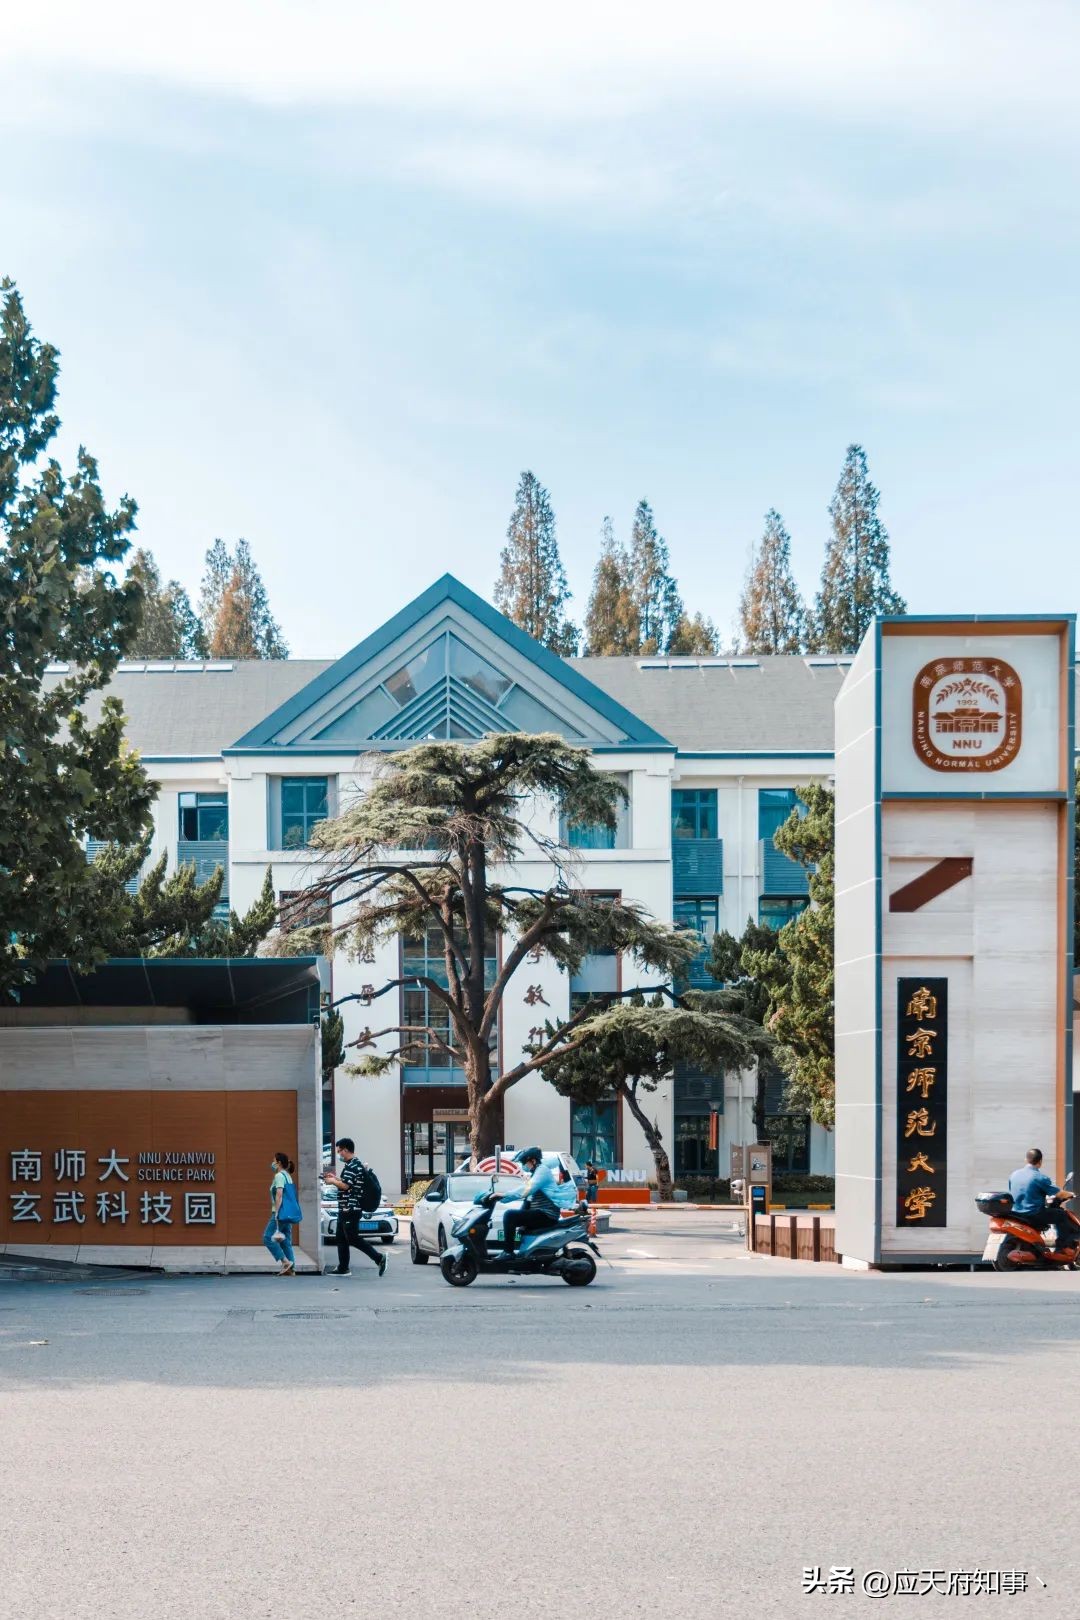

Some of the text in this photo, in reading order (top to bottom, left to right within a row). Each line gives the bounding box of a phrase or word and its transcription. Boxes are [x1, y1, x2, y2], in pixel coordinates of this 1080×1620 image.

[917, 711, 1017, 768] NANJING NORMAL UNIVERSITY
[952, 739, 982, 749] NNU
[905, 986, 938, 1219] 南京师范大学
[10, 1149, 129, 1182] 南师大
[139, 1152, 215, 1164] NNU XUANWU
[138, 1168, 215, 1181] SCIENCE PARK
[607, 1169, 647, 1182] NNU
[10, 1190, 216, 1225] 玄武科技园
